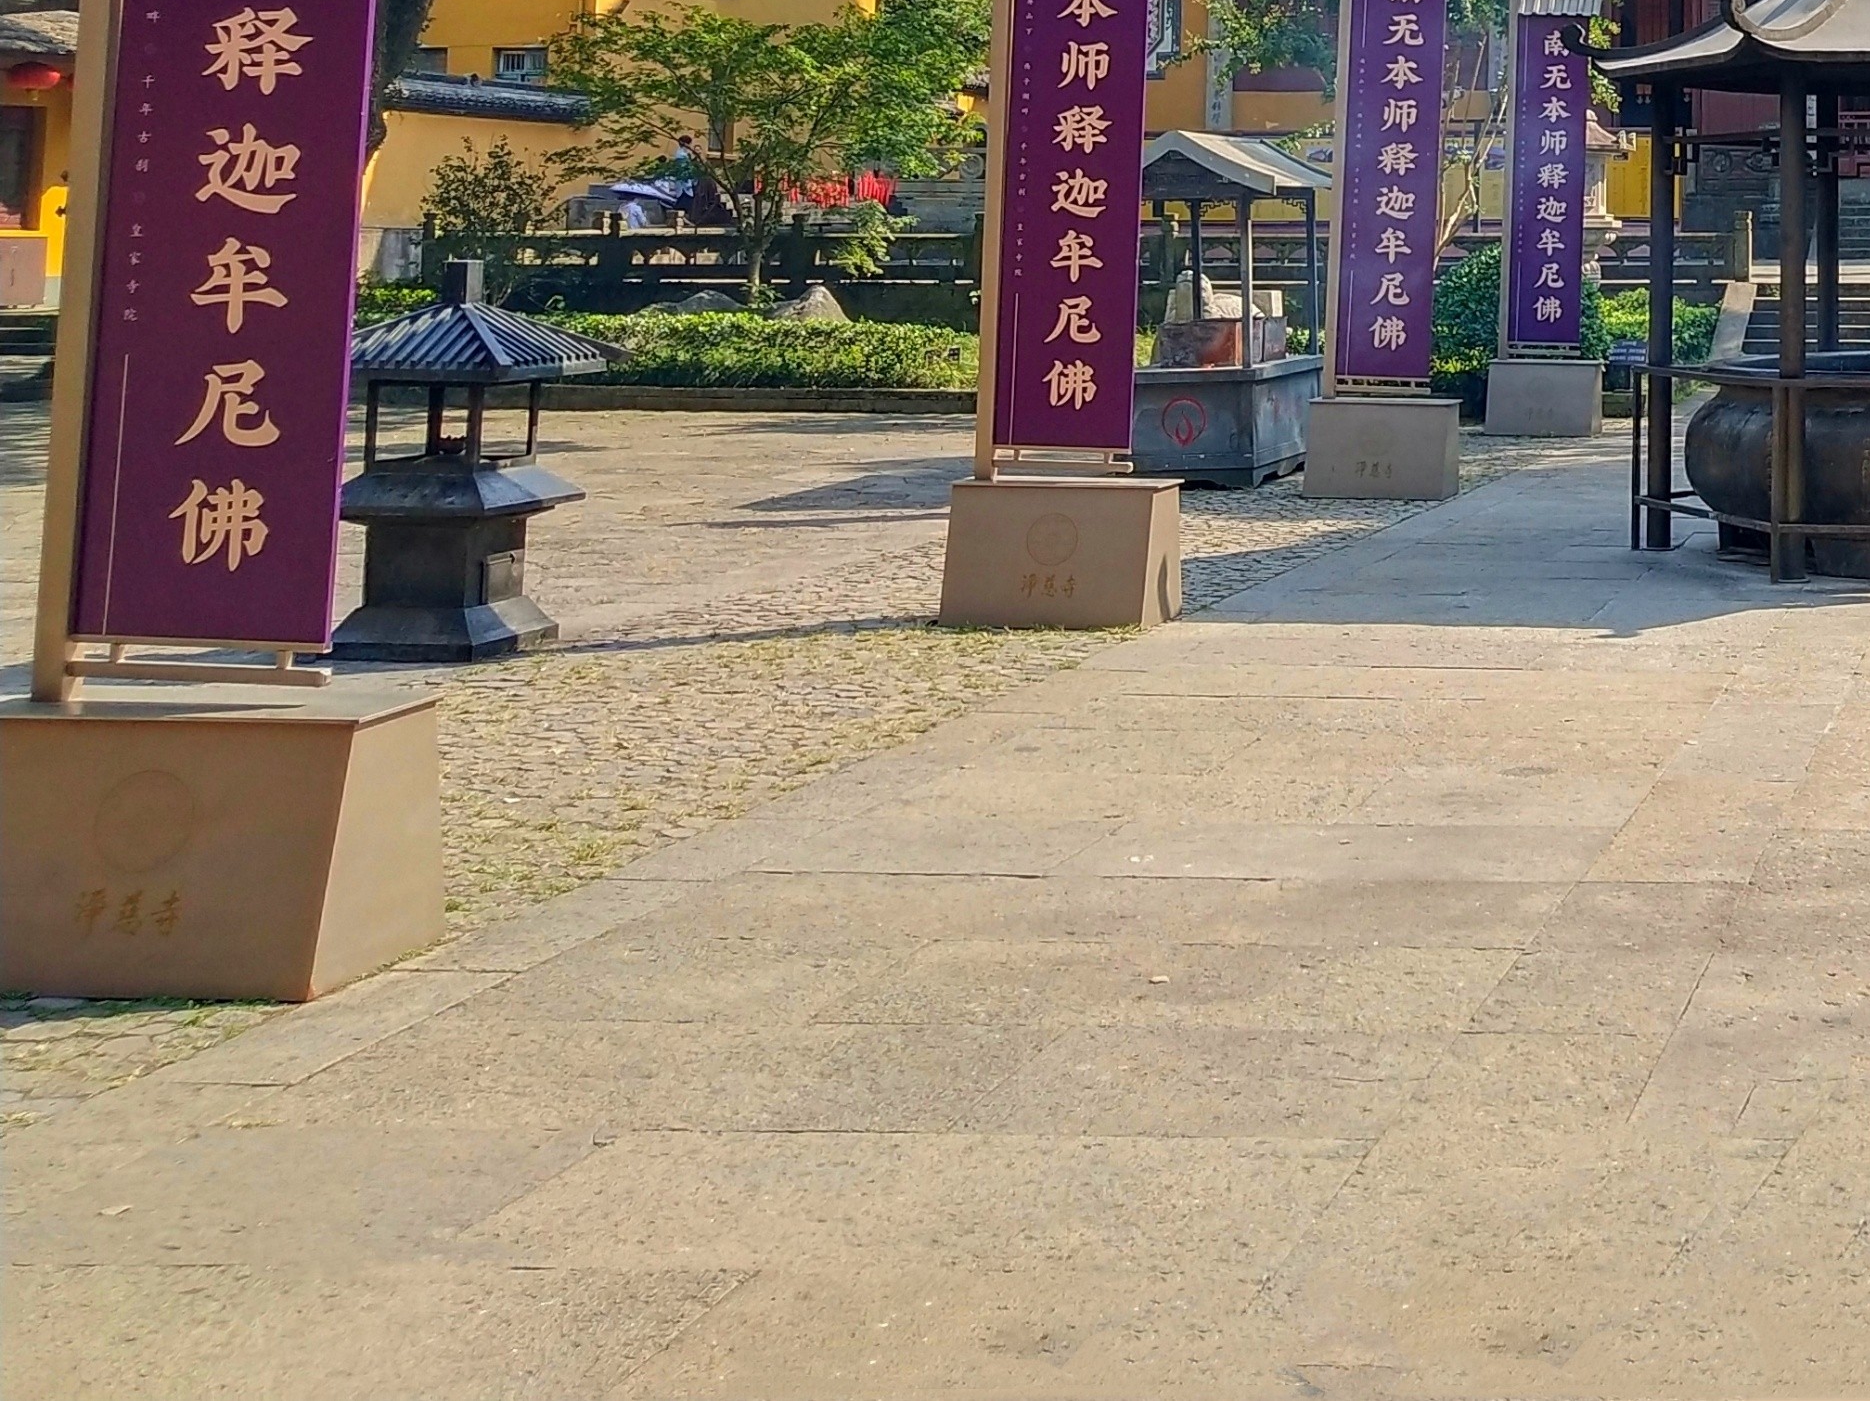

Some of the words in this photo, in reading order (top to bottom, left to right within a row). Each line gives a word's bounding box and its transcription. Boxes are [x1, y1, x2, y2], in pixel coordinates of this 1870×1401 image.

[1532, 30, 1572, 325] 南无本师释迦牟尼佛
